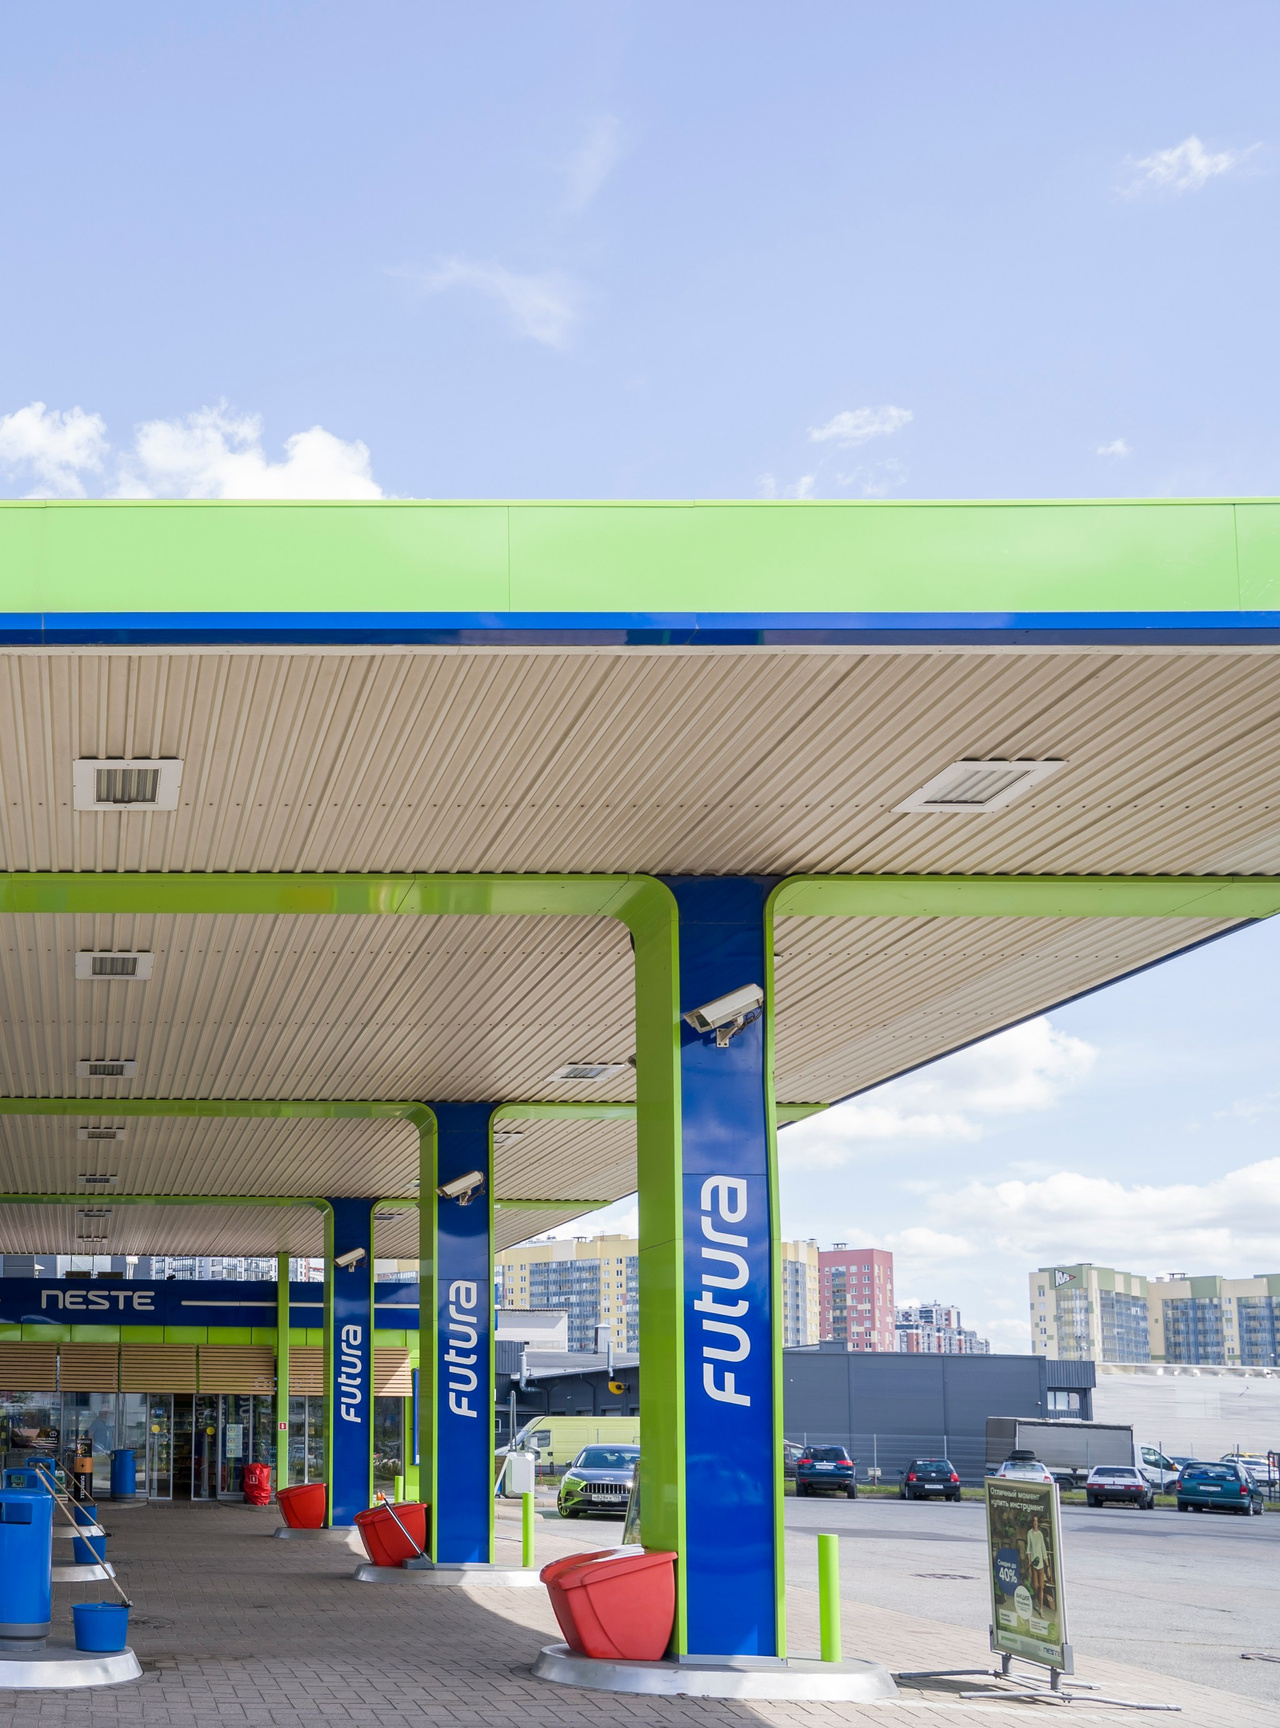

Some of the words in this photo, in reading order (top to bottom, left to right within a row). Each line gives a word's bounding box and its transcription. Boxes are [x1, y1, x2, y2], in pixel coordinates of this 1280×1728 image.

[41, 1290, 155, 1310] NESTE
[693, 1175, 751, 1407] Futura
[337, 1324, 362, 1423] Futura
[444, 1280, 478, 1418] Futura
[999, 1567, 1018, 1583] 40%
